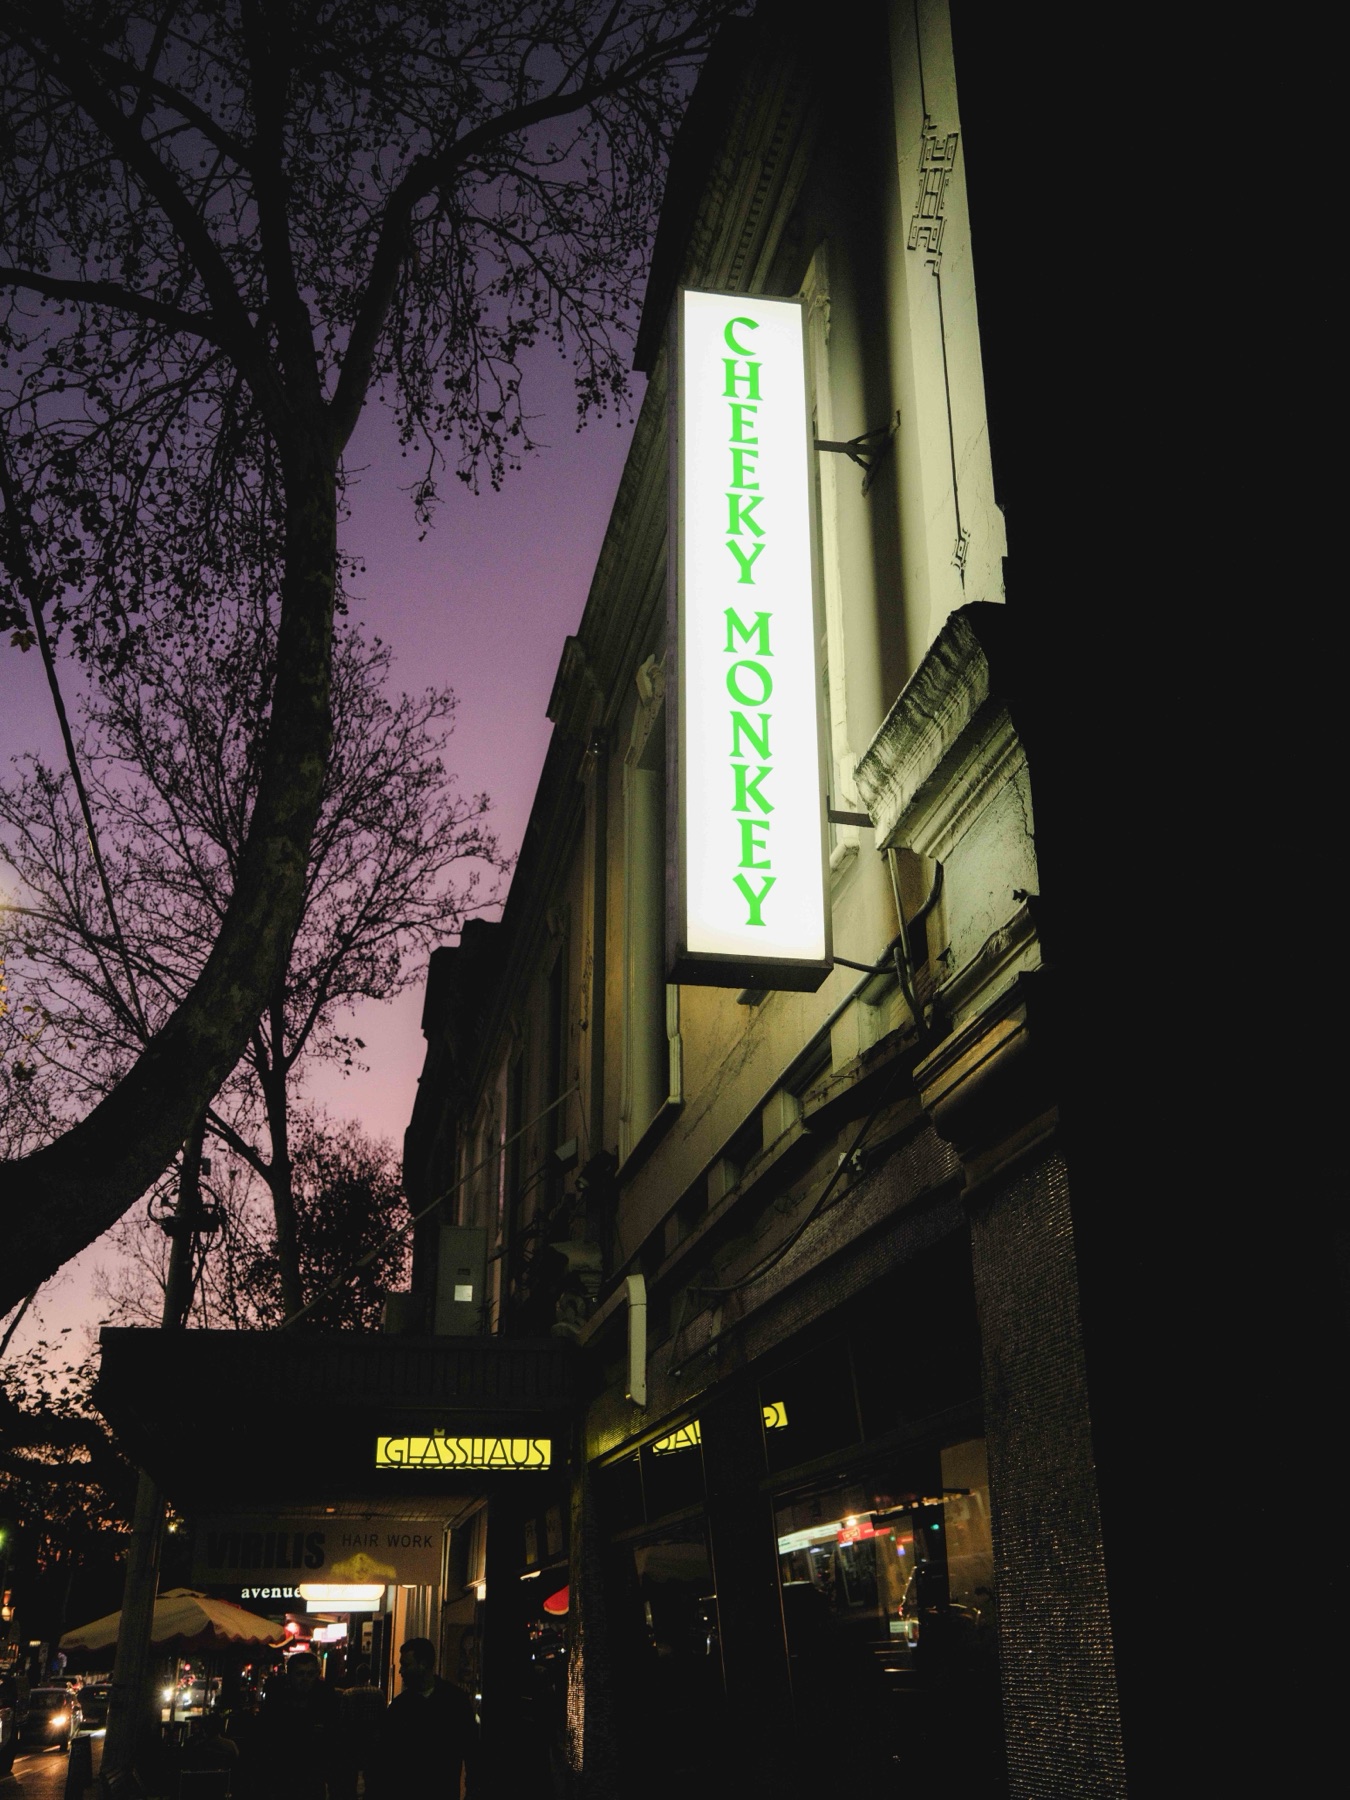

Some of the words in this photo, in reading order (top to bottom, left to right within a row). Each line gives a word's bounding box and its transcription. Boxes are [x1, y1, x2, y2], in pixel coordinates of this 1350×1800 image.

[723, 317, 765, 585] CHEEKY
[723, 607, 777, 926] MONKEY
[382, 1437, 548, 1465] GLASSHAUS
[207, 1531, 326, 1569] VIRILIS
[342, 1534, 379, 1548] HAIR
[387, 1535, 434, 1549] WORK
[241, 1587, 302, 1599] avenue
